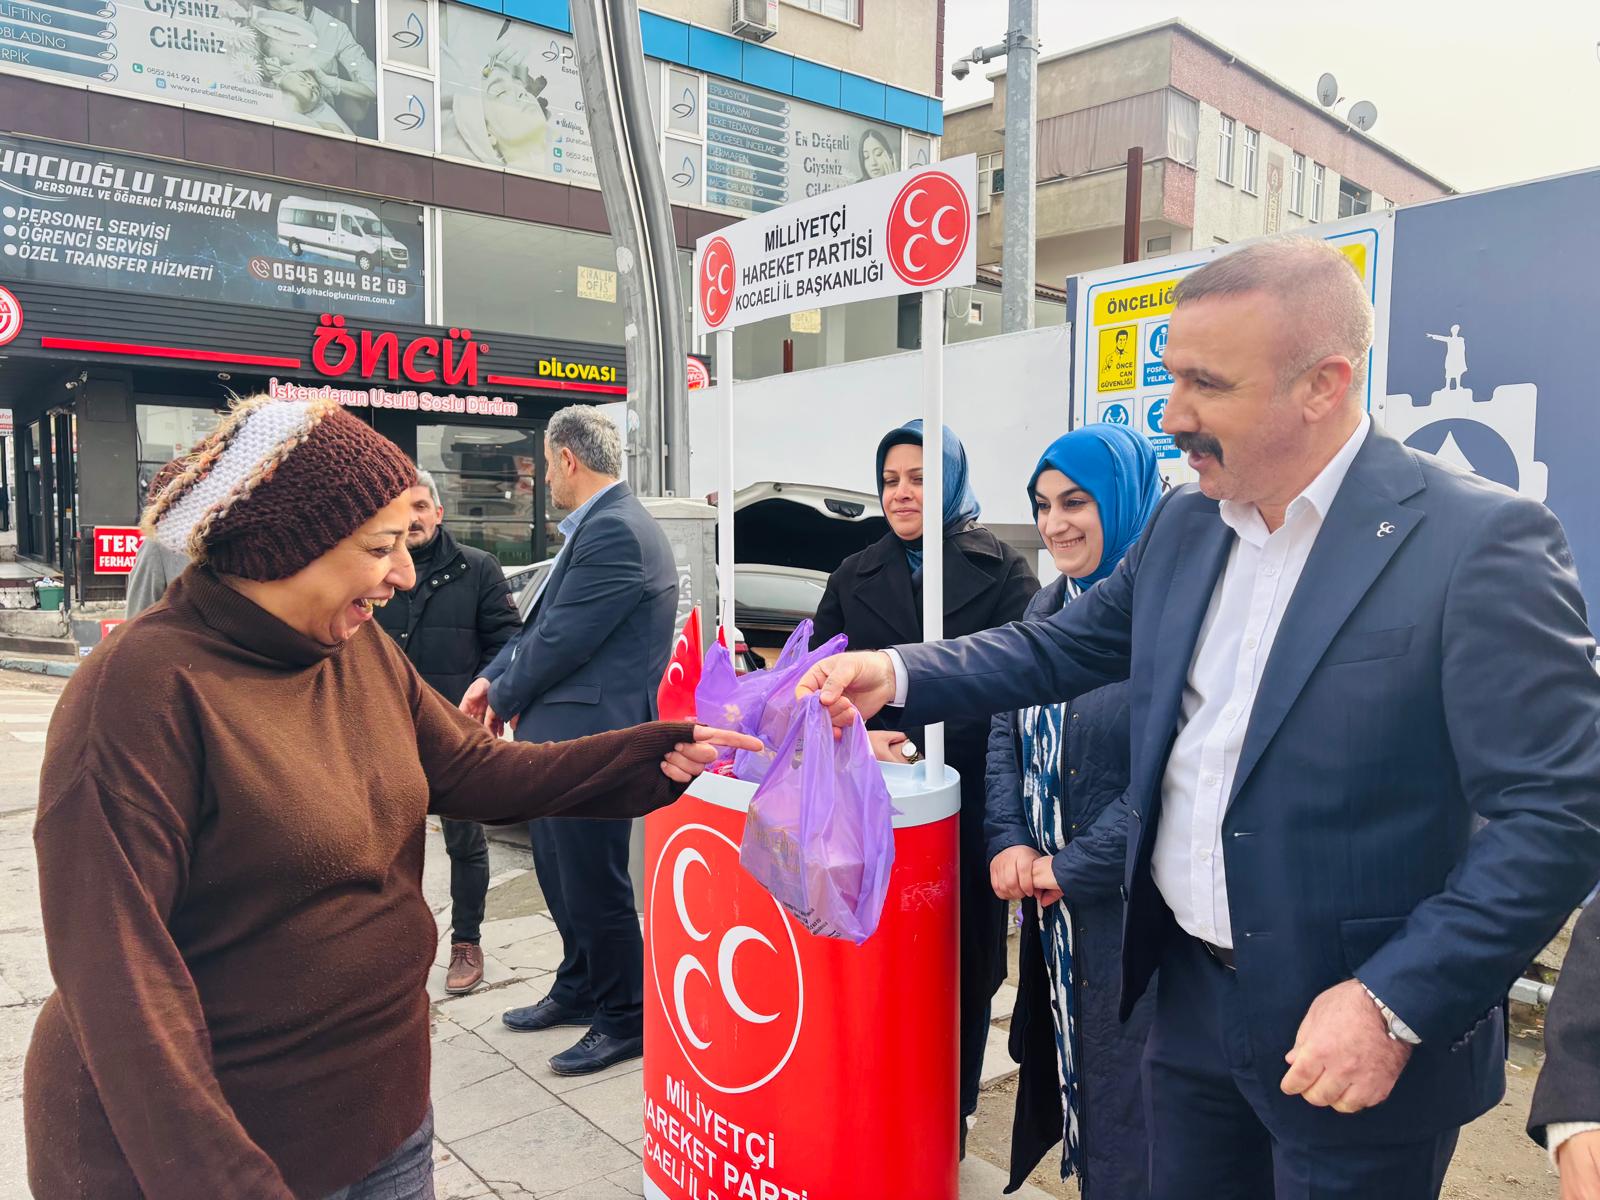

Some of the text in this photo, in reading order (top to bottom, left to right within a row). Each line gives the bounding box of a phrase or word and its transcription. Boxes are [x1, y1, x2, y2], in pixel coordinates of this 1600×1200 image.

[35, 180, 236, 219] PERSONEL VE ÖĞRENCİ TAŞIMACILIĞI
[162, 175, 273, 213] TURİZM
[17, 207, 171, 241] PERSONEL SERVİSİ
[18, 221, 159, 257] ÖĞRENCİ SERVİSİ
[764, 204, 846, 253] MİLLİYETÇİ
[18, 241, 214, 281] ÖZEL TRANSFER HİZMETİ
[273, 262, 318, 284] 0545
[323, 269, 356, 289] 344
[361, 275, 381, 292] 62
[742, 229, 873, 287] HAREKET PARTİSİ
[735, 260, 884, 312] KOCAELİ İL BAŞKANLIĞI
[538, 357, 616, 383] DİLOVASI
[420, 393, 466, 413] Soslu
[467, 395, 519, 417] Dürüm
[666, 1074, 775, 1170] MİLİYETÇİ
